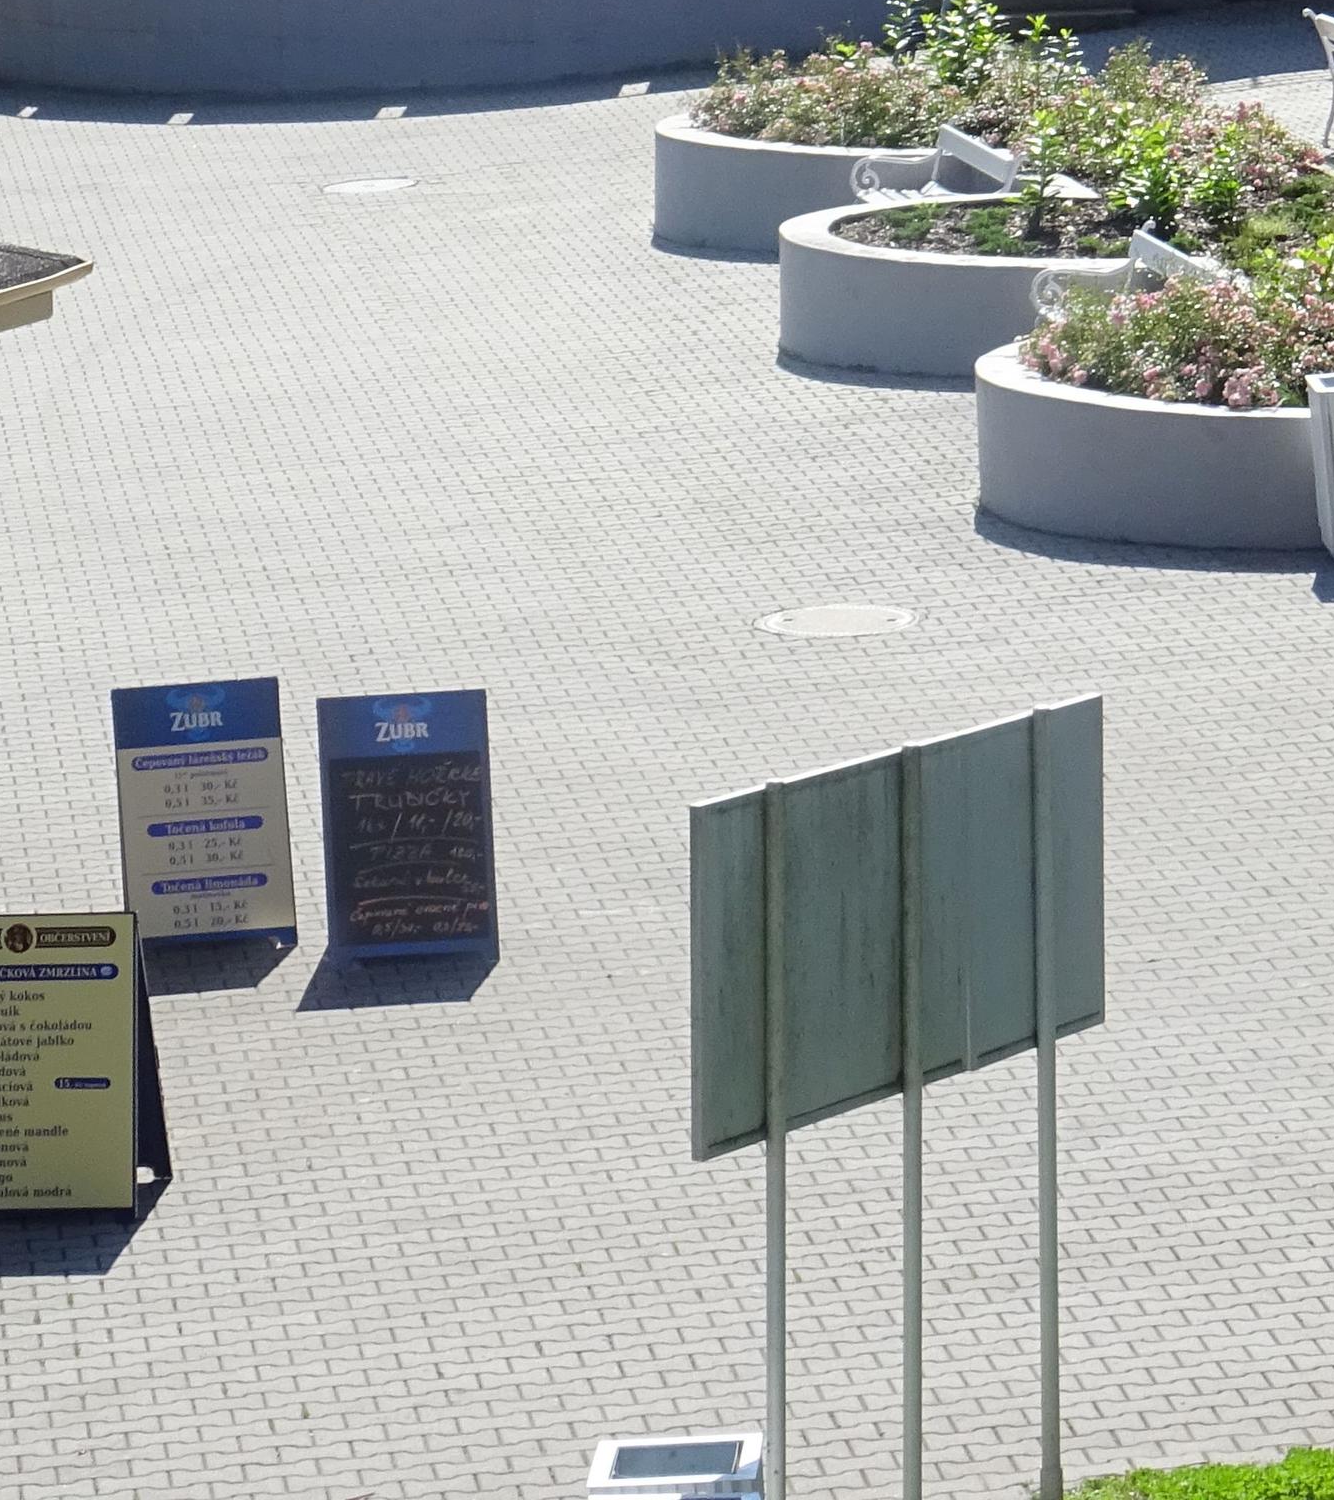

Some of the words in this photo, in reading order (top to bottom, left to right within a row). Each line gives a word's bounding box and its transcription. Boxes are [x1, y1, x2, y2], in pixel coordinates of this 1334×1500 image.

[170, 711, 223, 732] ZUBR
[374, 721, 429, 743] ZUBR
[224, 778, 238, 789] Kč
[225, 792, 238, 803] Kč
[165, 822, 207, 837] Točená
[169, 841, 186, 851] 0,3
[229, 836, 242, 847] Kč
[230, 851, 244, 861] Kč
[161, 880, 203, 895] Točená
[204, 875, 258, 890] limonáda
[234, 900, 248, 911] Kč
[235, 914, 249, 925] Kč
[39, 929, 111, 943] OBČERSTVENÍ
[38, 966, 98, 979] ZMRZLINA
[9, 990, 45, 1001] kokos
[29, 1019, 92, 1031] čokoládou
[36, 1034, 75, 1047] jablko
[23, 1125, 69, 1138] mandle
[33, 1184, 72, 1197] modrá
